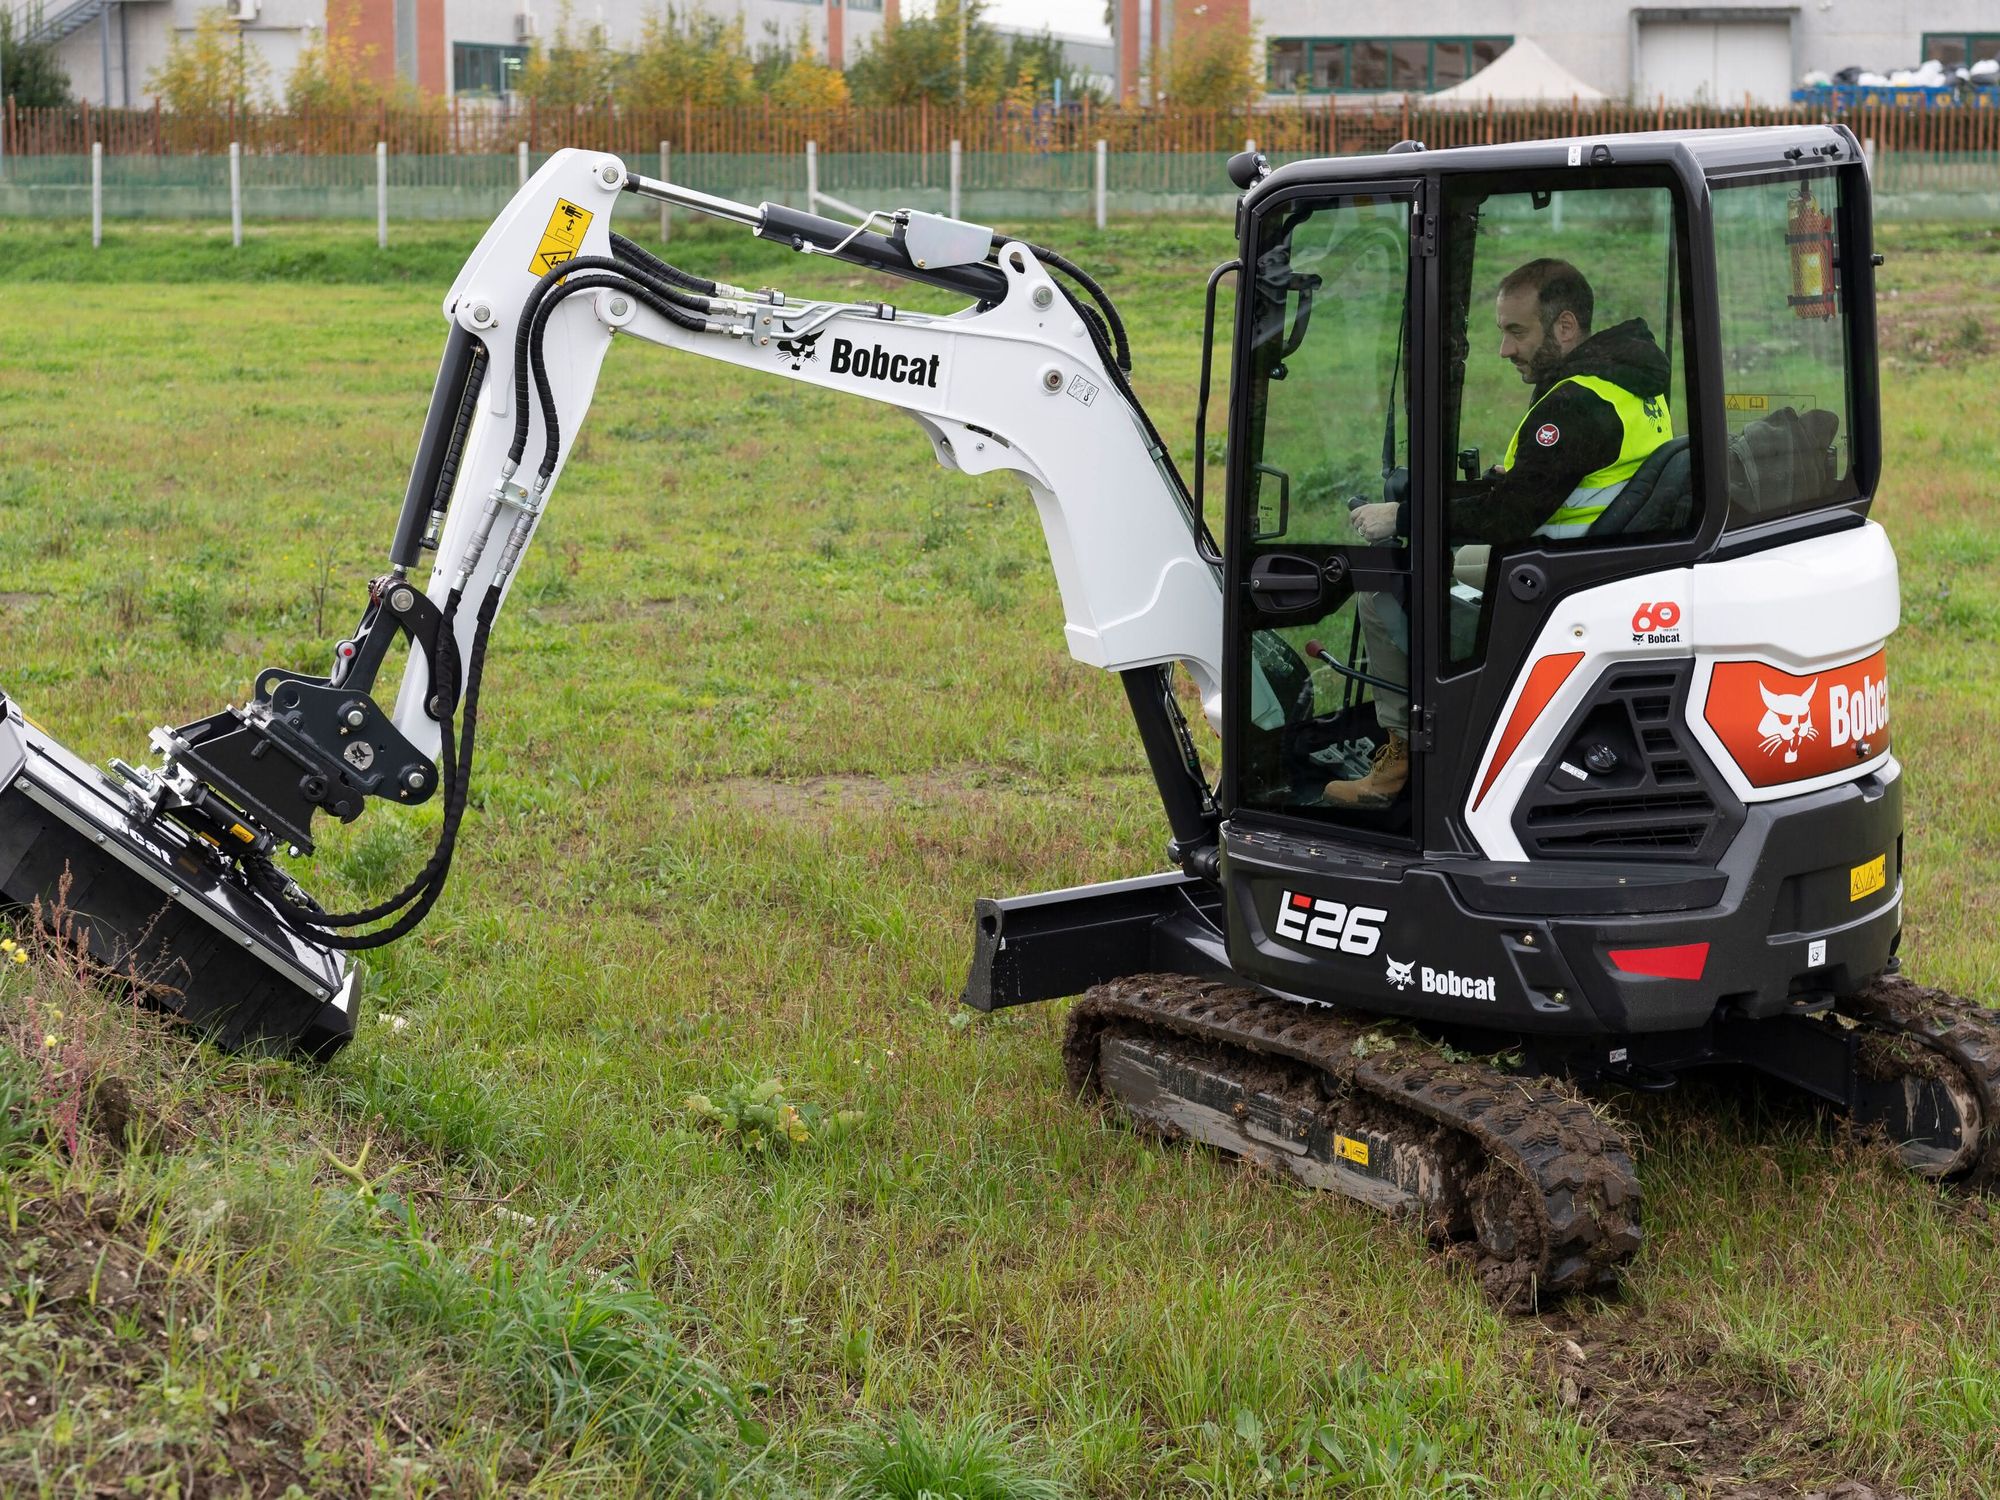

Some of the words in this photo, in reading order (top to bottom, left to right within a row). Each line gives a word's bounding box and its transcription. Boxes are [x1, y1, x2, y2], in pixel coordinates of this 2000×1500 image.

[830, 338, 940, 388] Bobcat
[1632, 601, 1680, 632] 60
[1648, 633, 1680, 643] Bobcat
[1275, 890, 1388, 956] E26
[1421, 966, 1496, 1002] Bobcat
